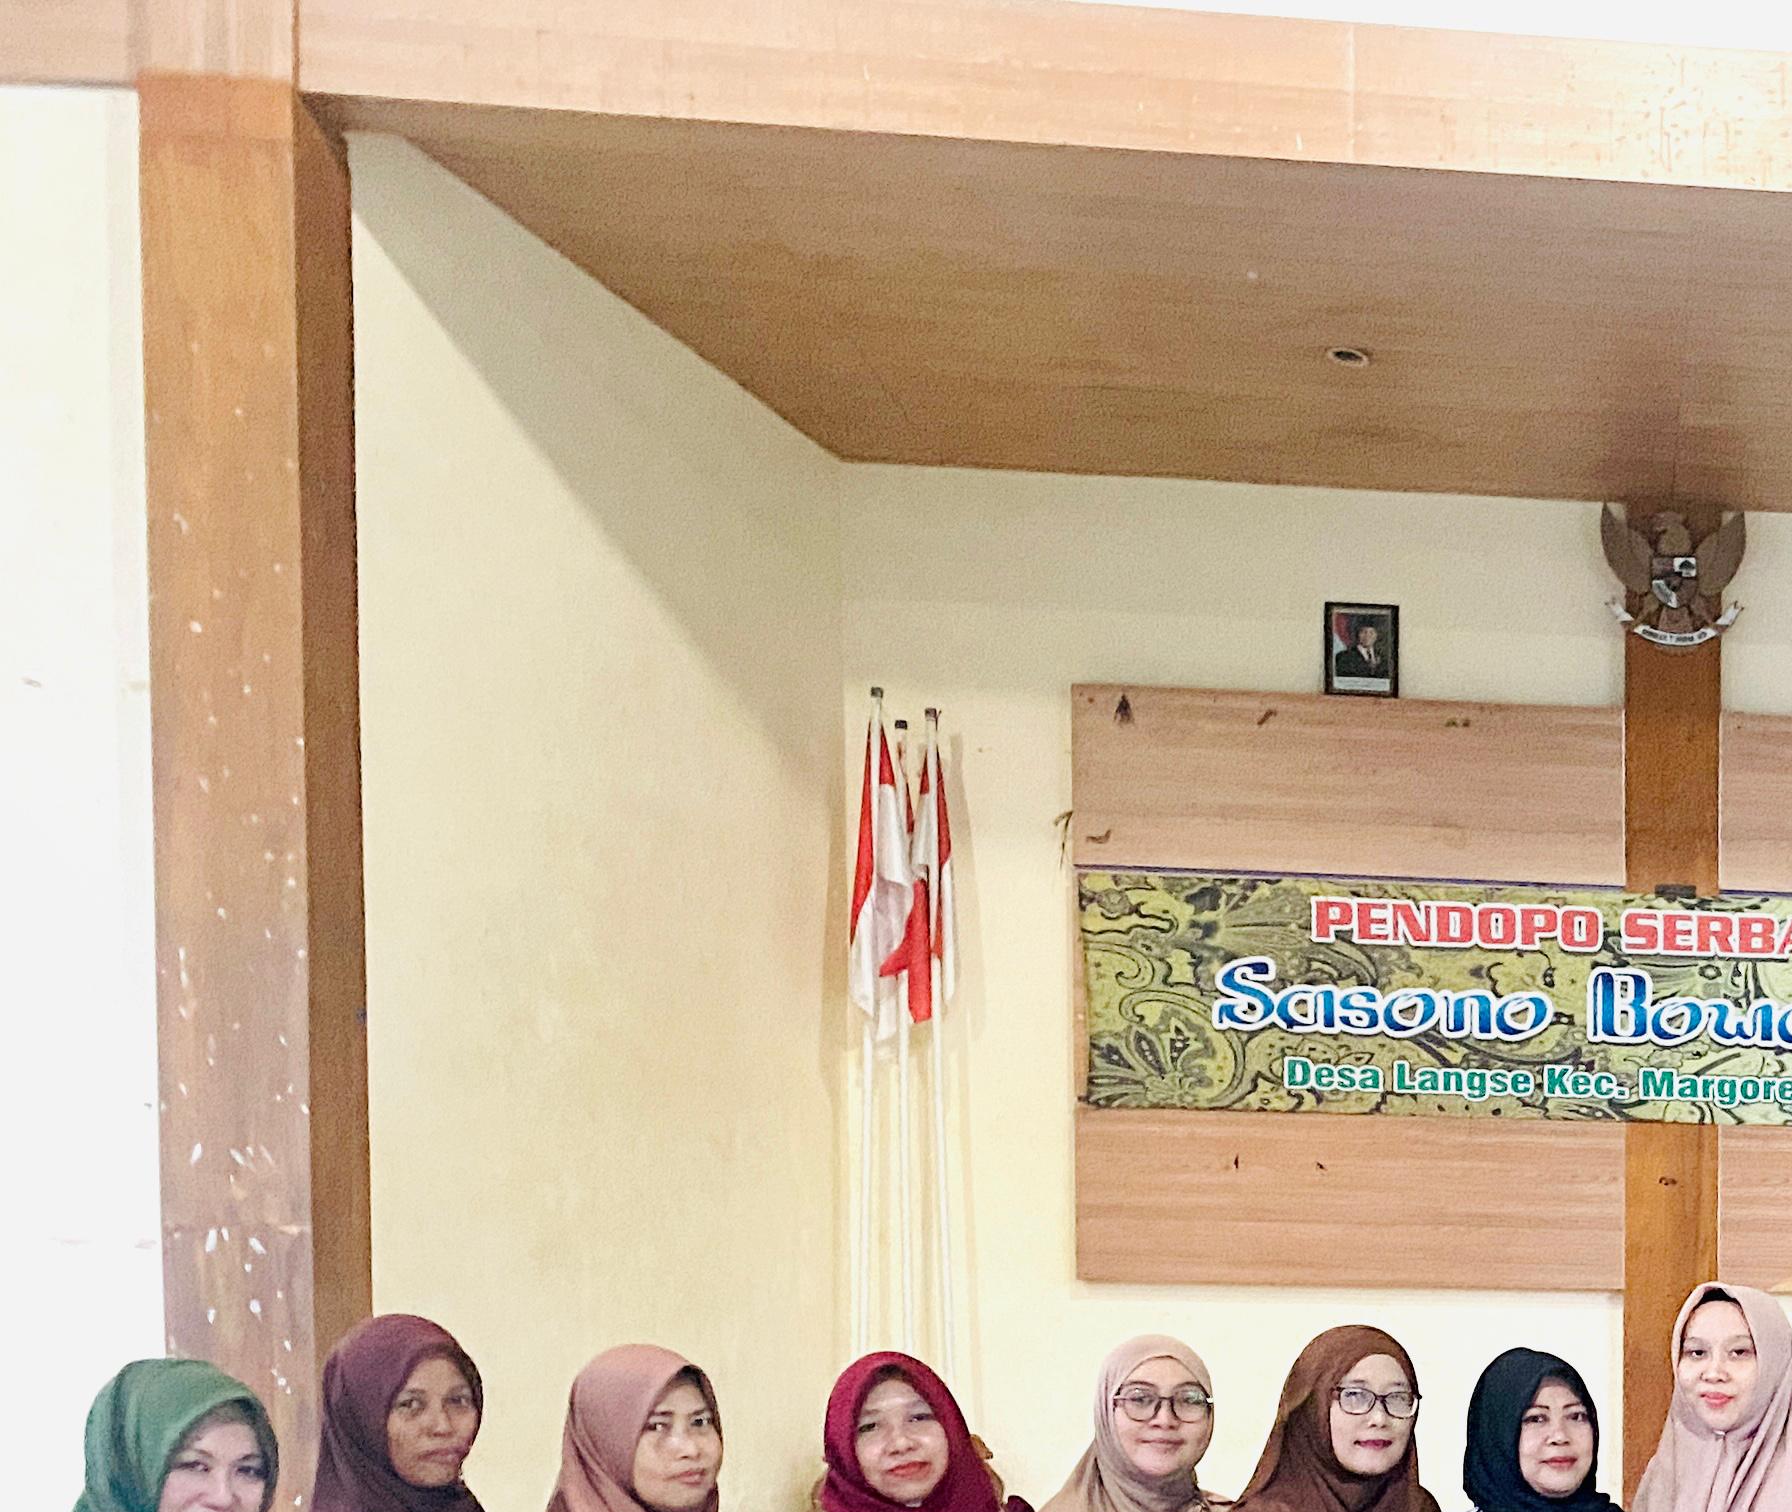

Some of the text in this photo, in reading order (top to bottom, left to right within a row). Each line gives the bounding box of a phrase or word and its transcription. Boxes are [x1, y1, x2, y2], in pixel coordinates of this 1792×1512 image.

[1313, 898, 1600, 950] PENDOPO
[1216, 960, 1550, 1038] Sasono
[1286, 1058, 1382, 1091] Desa
[1396, 1061, 1532, 1098] Langse
[1546, 1066, 1628, 1097] Kec.
